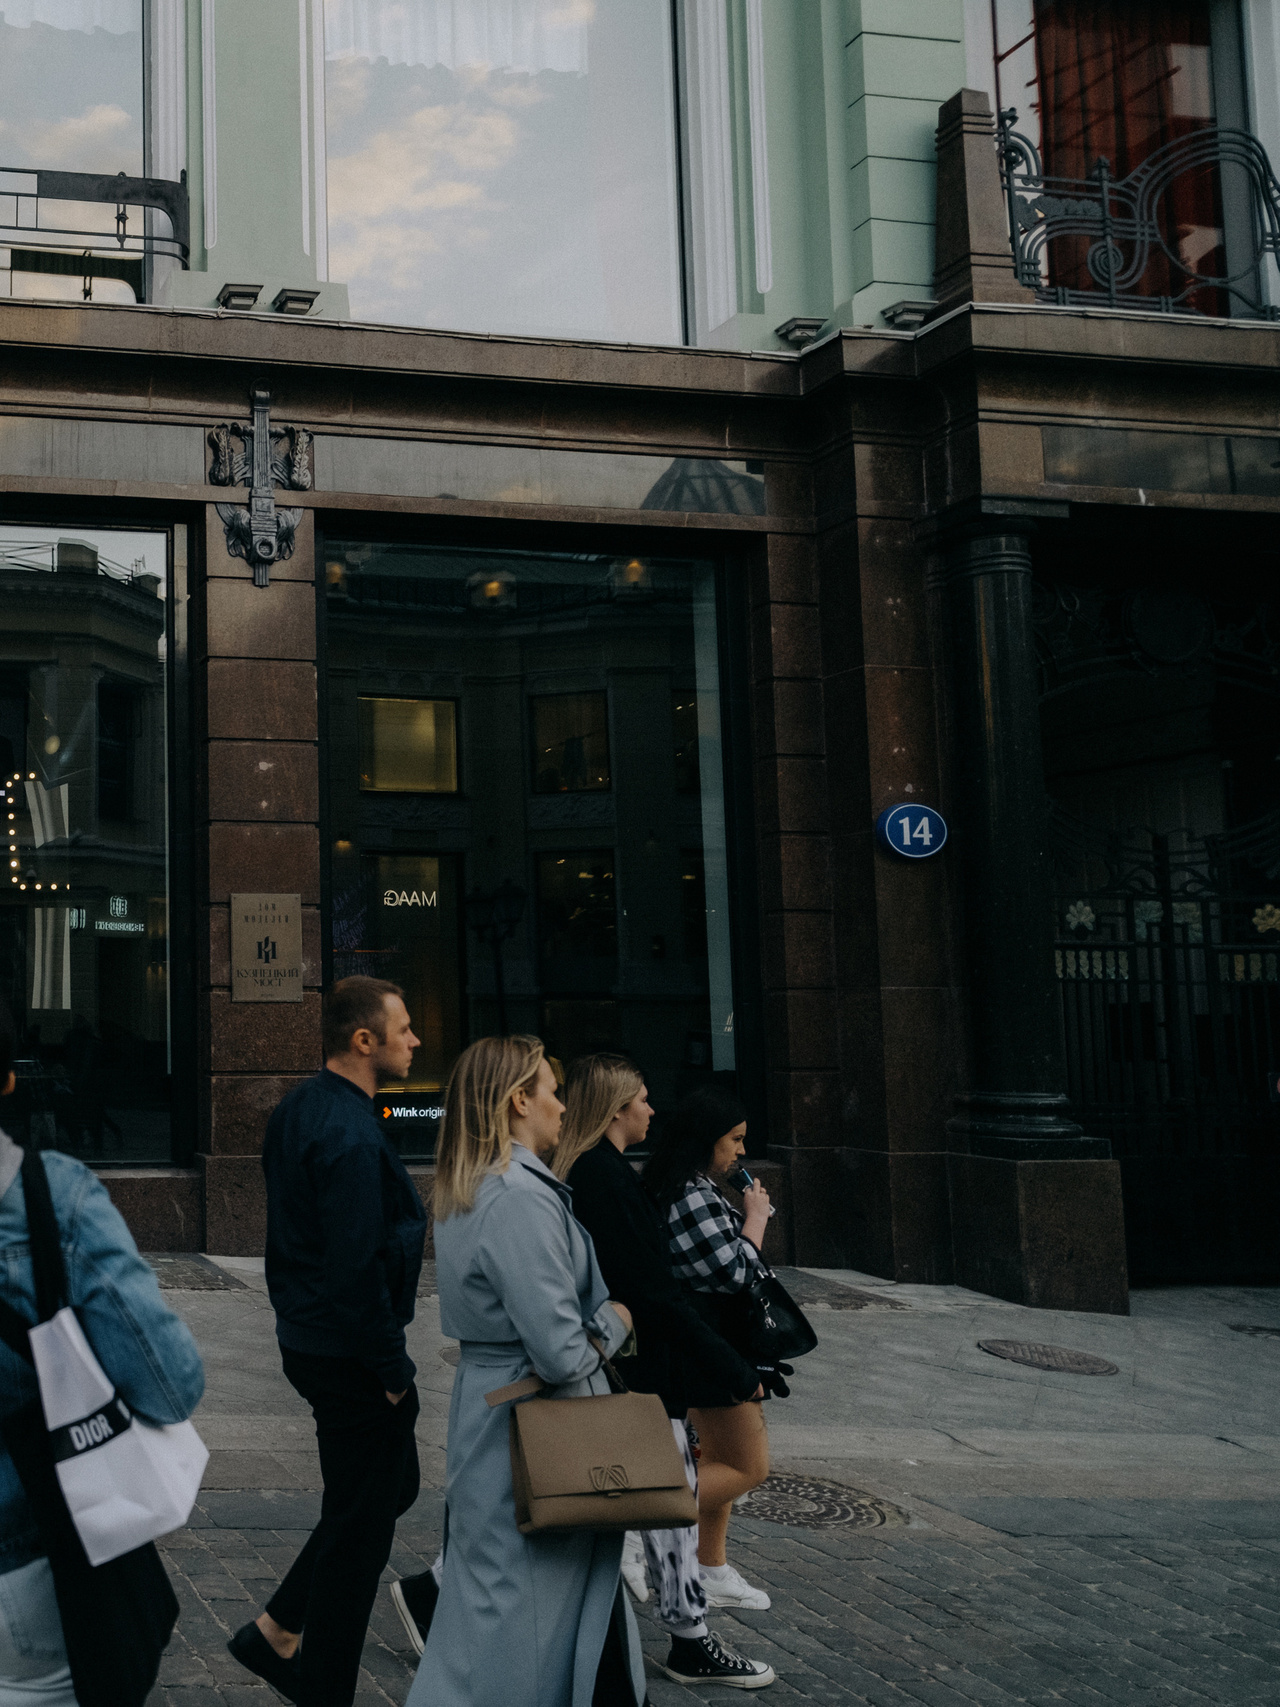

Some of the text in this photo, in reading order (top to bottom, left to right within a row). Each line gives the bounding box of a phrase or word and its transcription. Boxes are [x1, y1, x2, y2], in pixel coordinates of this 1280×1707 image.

[898, 816, 934, 846] 14
[391, 1106, 447, 1120] Wink origin
[69, 1412, 114, 1452] DIOR
